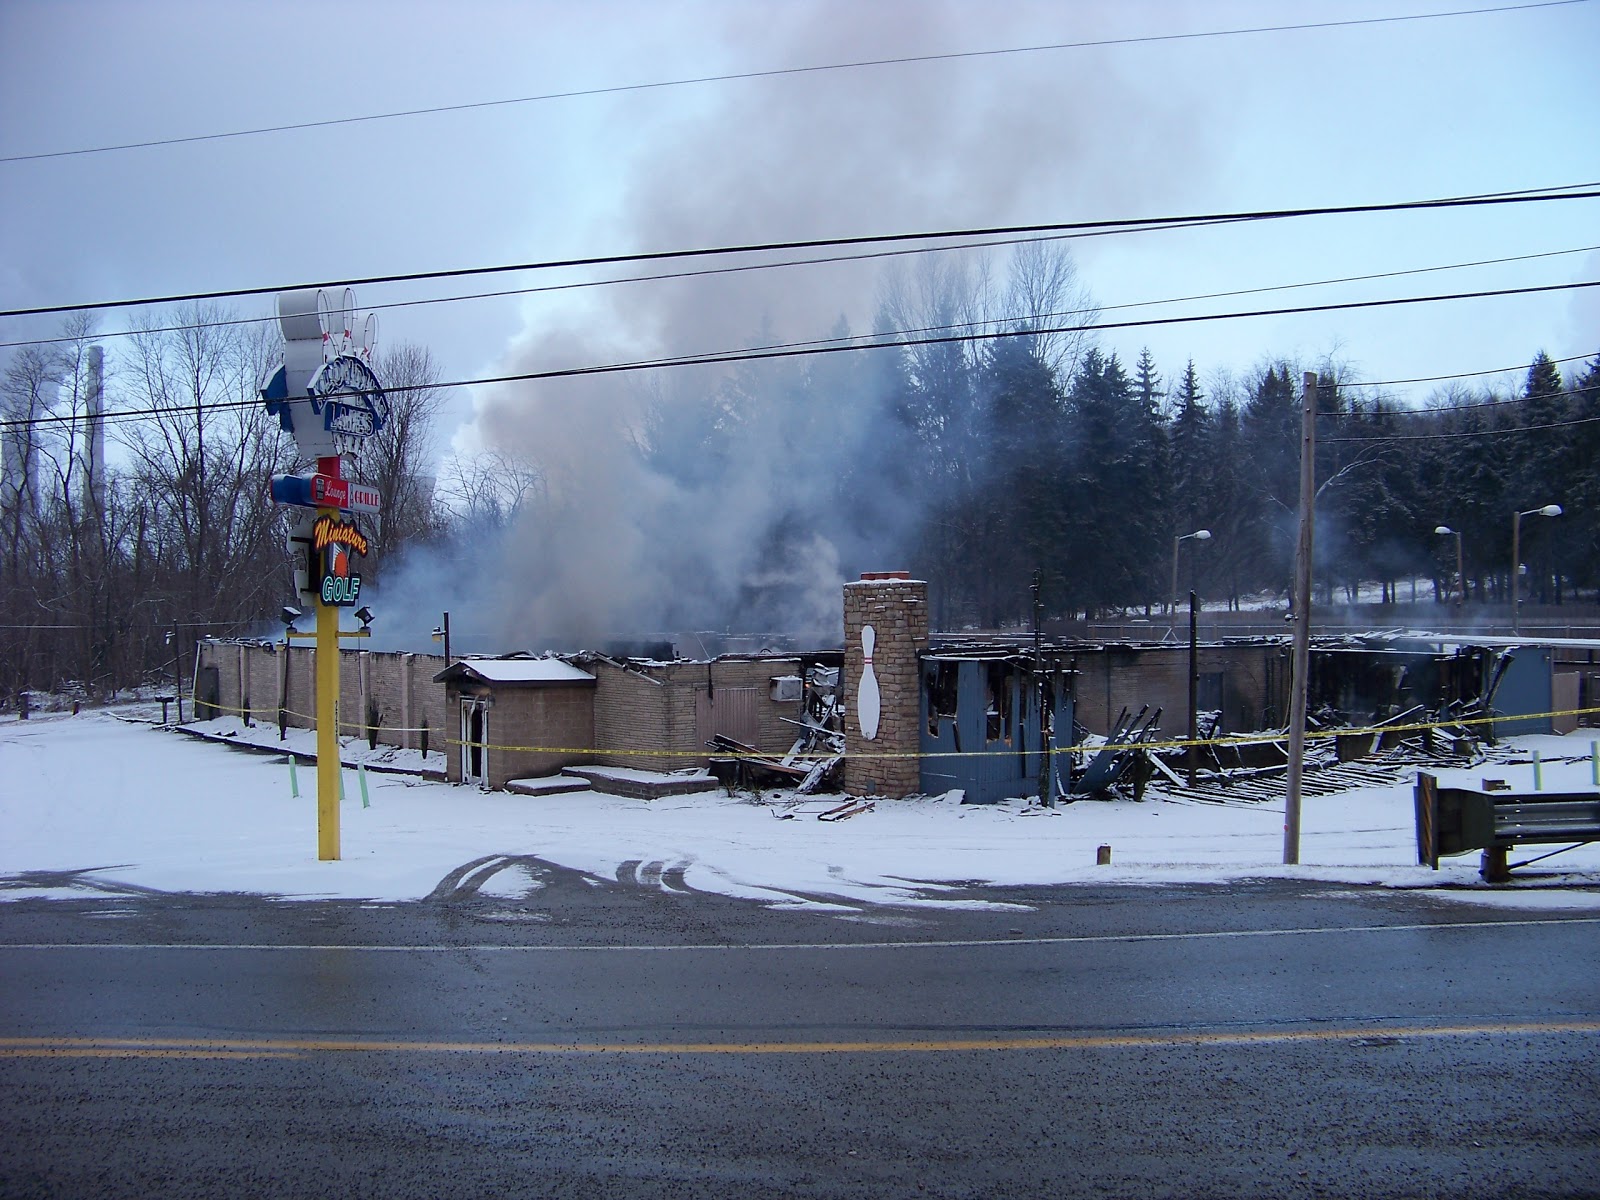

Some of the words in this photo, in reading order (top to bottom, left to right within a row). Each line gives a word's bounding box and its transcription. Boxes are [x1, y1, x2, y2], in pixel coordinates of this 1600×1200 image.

[330, 402, 374, 437] LANES
[325, 480, 347, 505] Lounge
[354, 490, 379, 507] GRILLE
[314, 518, 367, 554] Miniature
[322, 576, 361, 602] GOLF
